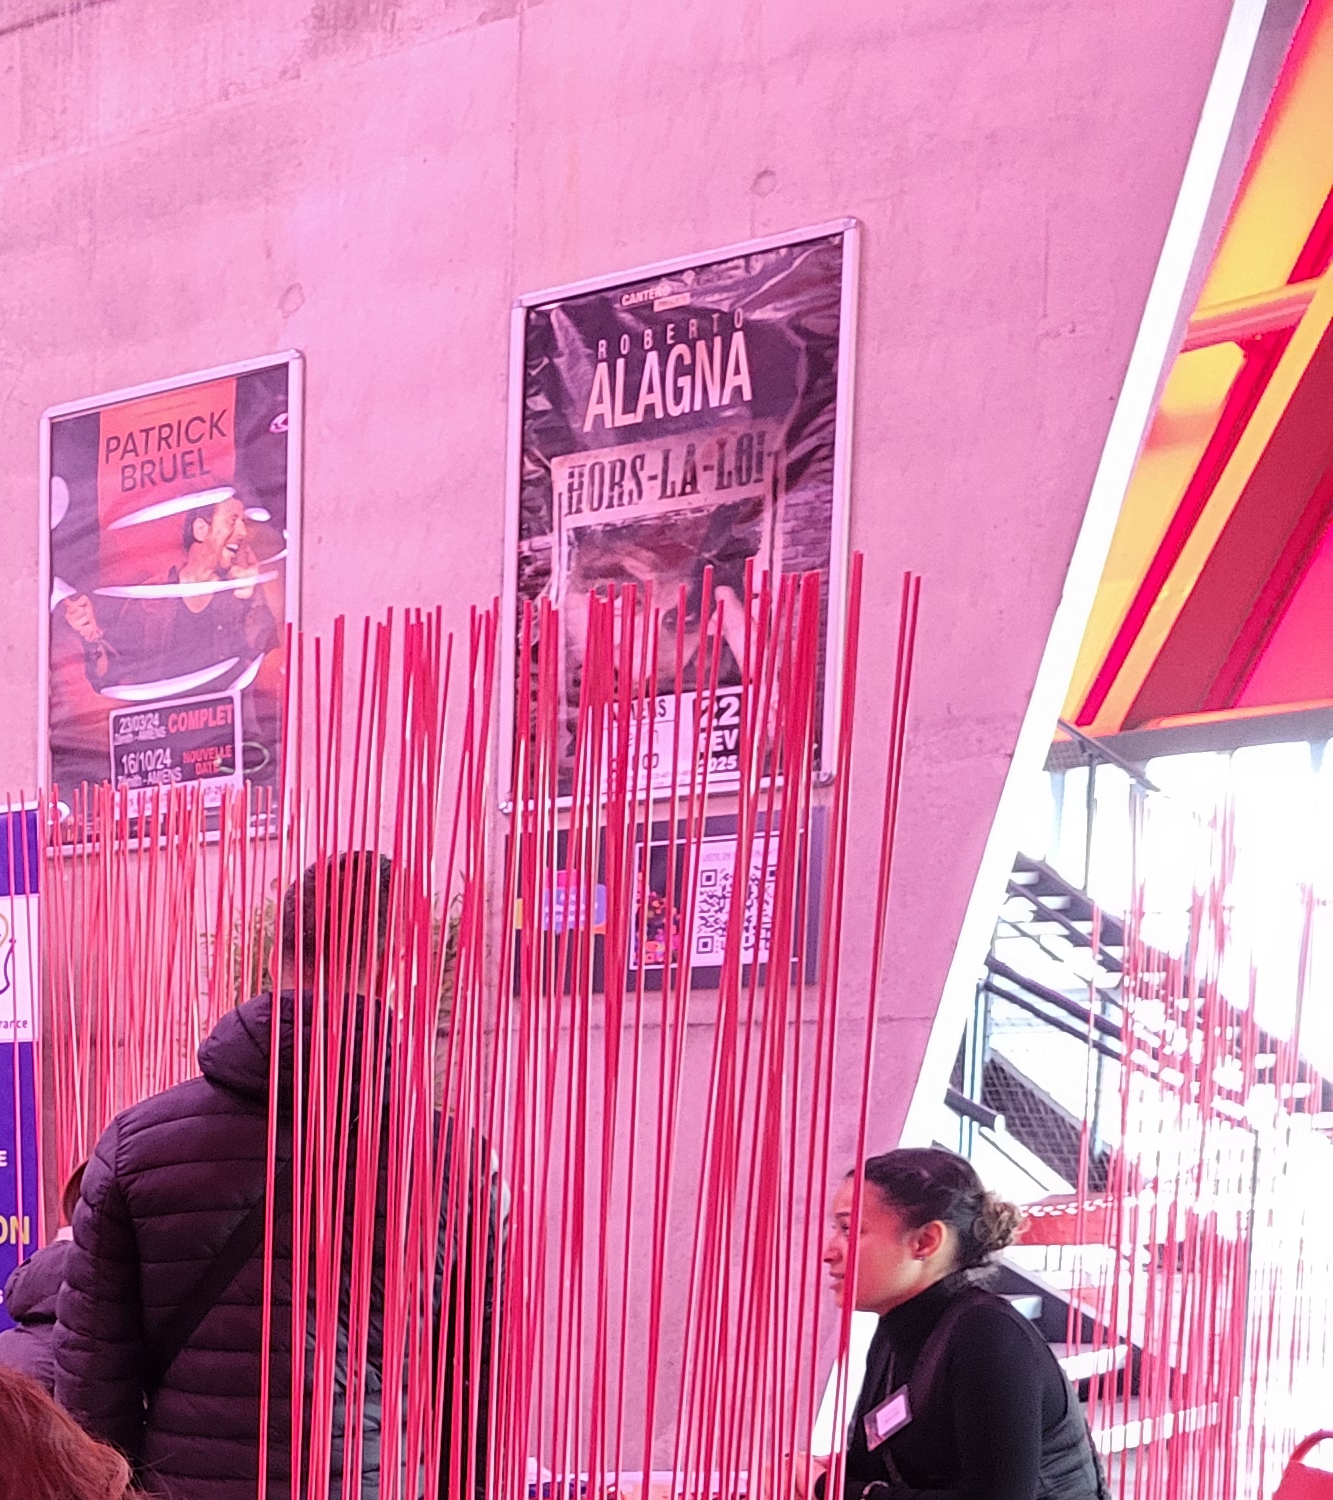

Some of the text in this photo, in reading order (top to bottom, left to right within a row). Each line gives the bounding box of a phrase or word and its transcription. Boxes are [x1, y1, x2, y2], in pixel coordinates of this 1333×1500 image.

[598, 308, 744, 359] ROBERTO
[583, 331, 753, 433] ALAGNA
[105, 408, 228, 464] PATRICK
[121, 447, 211, 492] BRUEL
[564, 430, 769, 517] HORS-LA-LOI
[167, 703, 233, 734] COMPLET
[121, 744, 232, 775] 16/10/24 NOUVELLE
[147, 766, 182, 785] AMIENS
[195, 760, 220, 776] DATE
